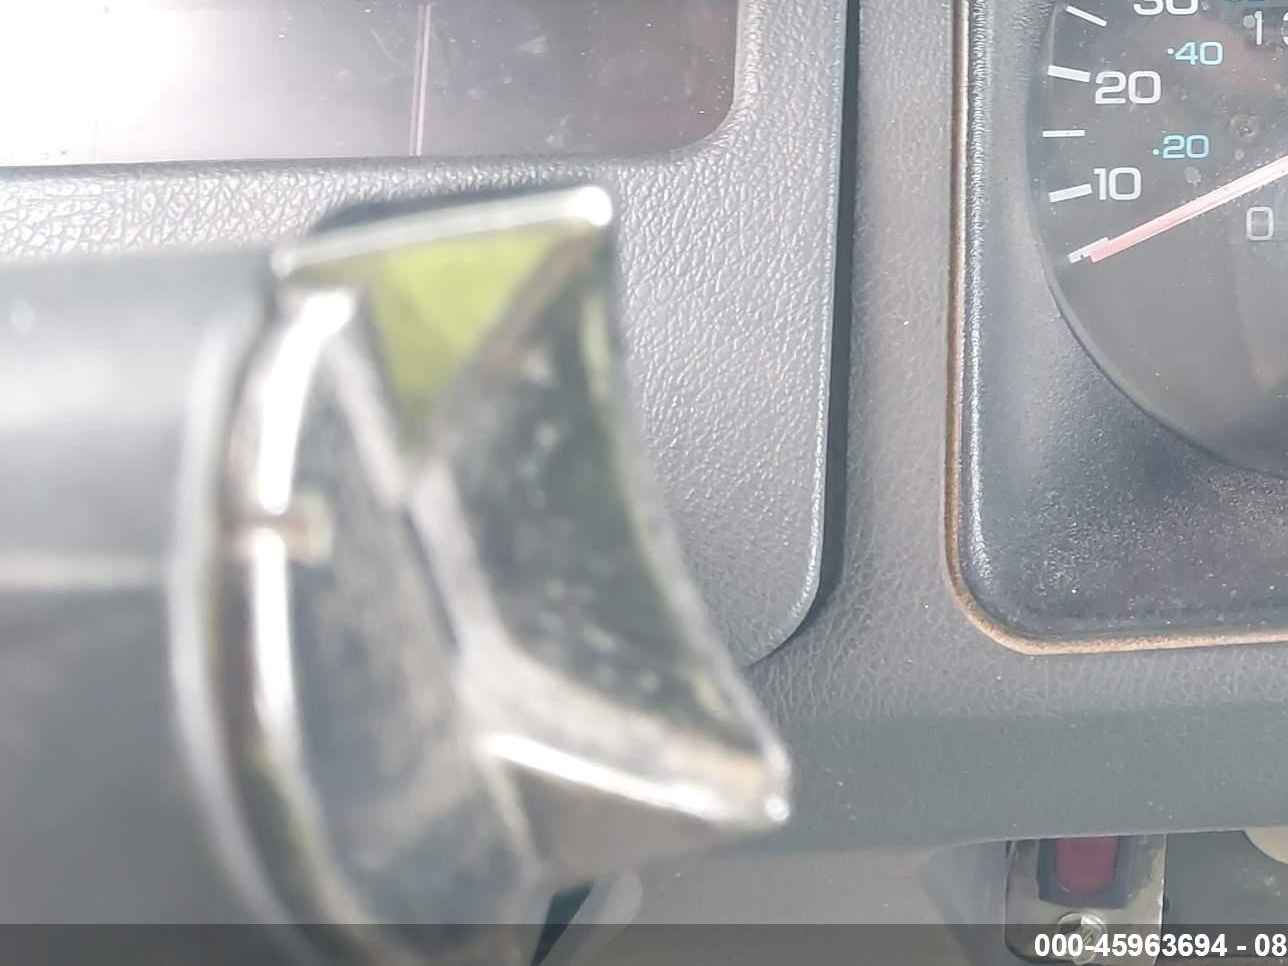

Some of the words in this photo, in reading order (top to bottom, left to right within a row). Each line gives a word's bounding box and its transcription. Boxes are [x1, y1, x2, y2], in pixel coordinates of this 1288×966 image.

[1174, 40, 1224, 66] 40
[1094, 71, 1162, 104] 20
[1160, 135, 1210, 160] 20
[1093, 168, 1142, 201] 10
